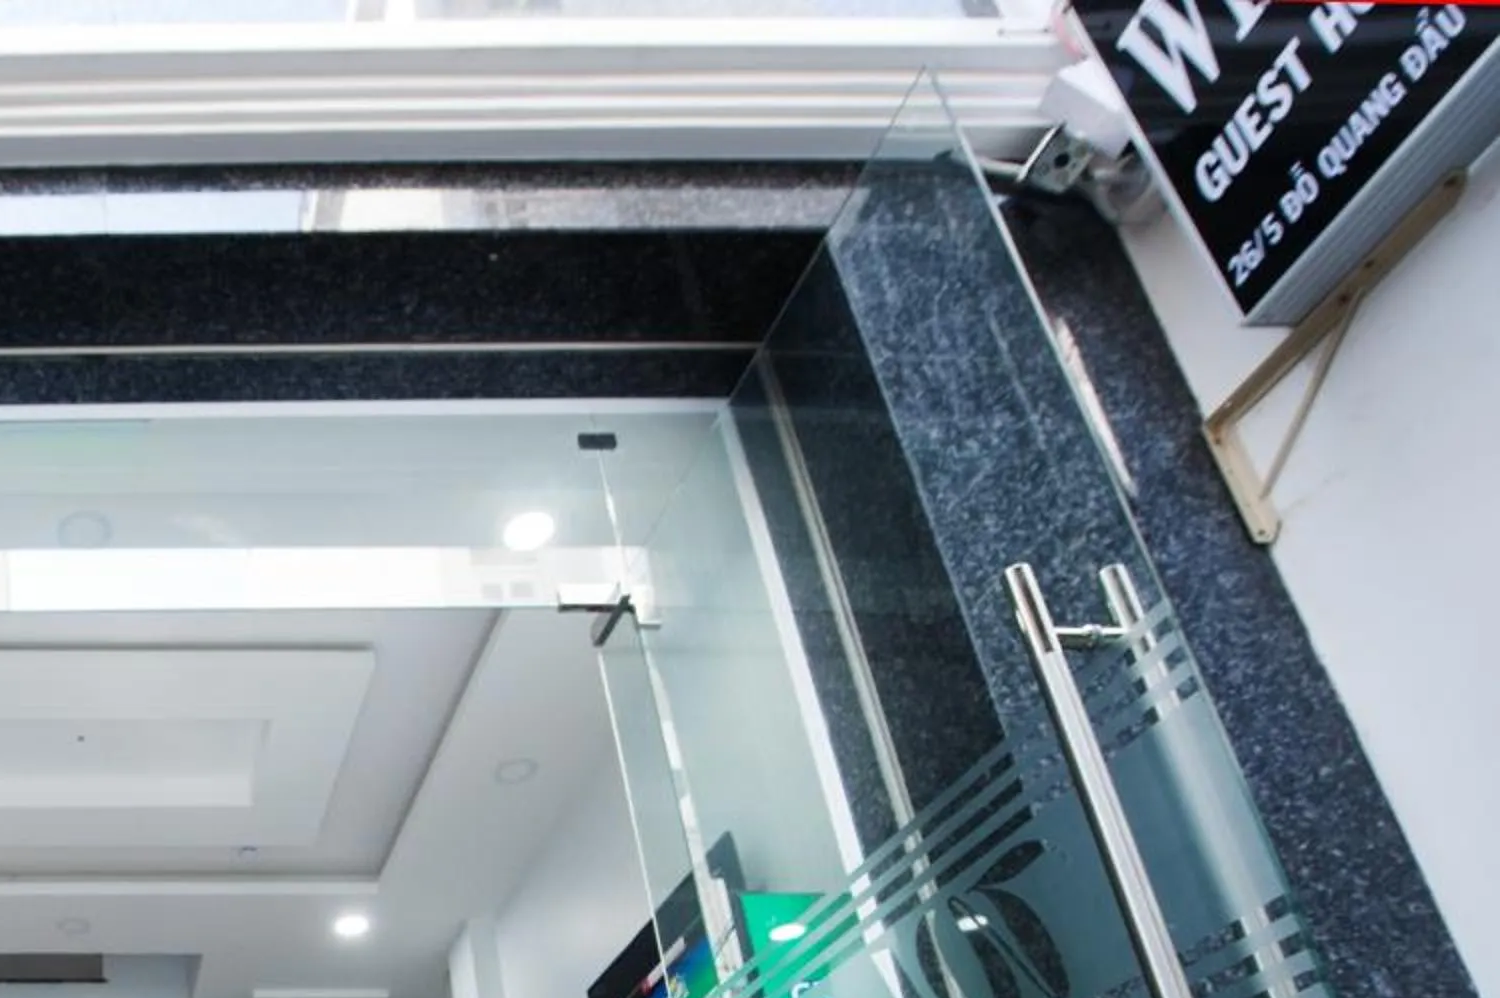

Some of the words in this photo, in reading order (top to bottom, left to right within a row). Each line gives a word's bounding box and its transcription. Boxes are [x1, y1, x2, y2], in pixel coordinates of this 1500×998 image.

[1194, 36, 1313, 202] GUEST
[1227, 211, 1285, 288] 26/5
[1317, 72, 1407, 178] QUANG
